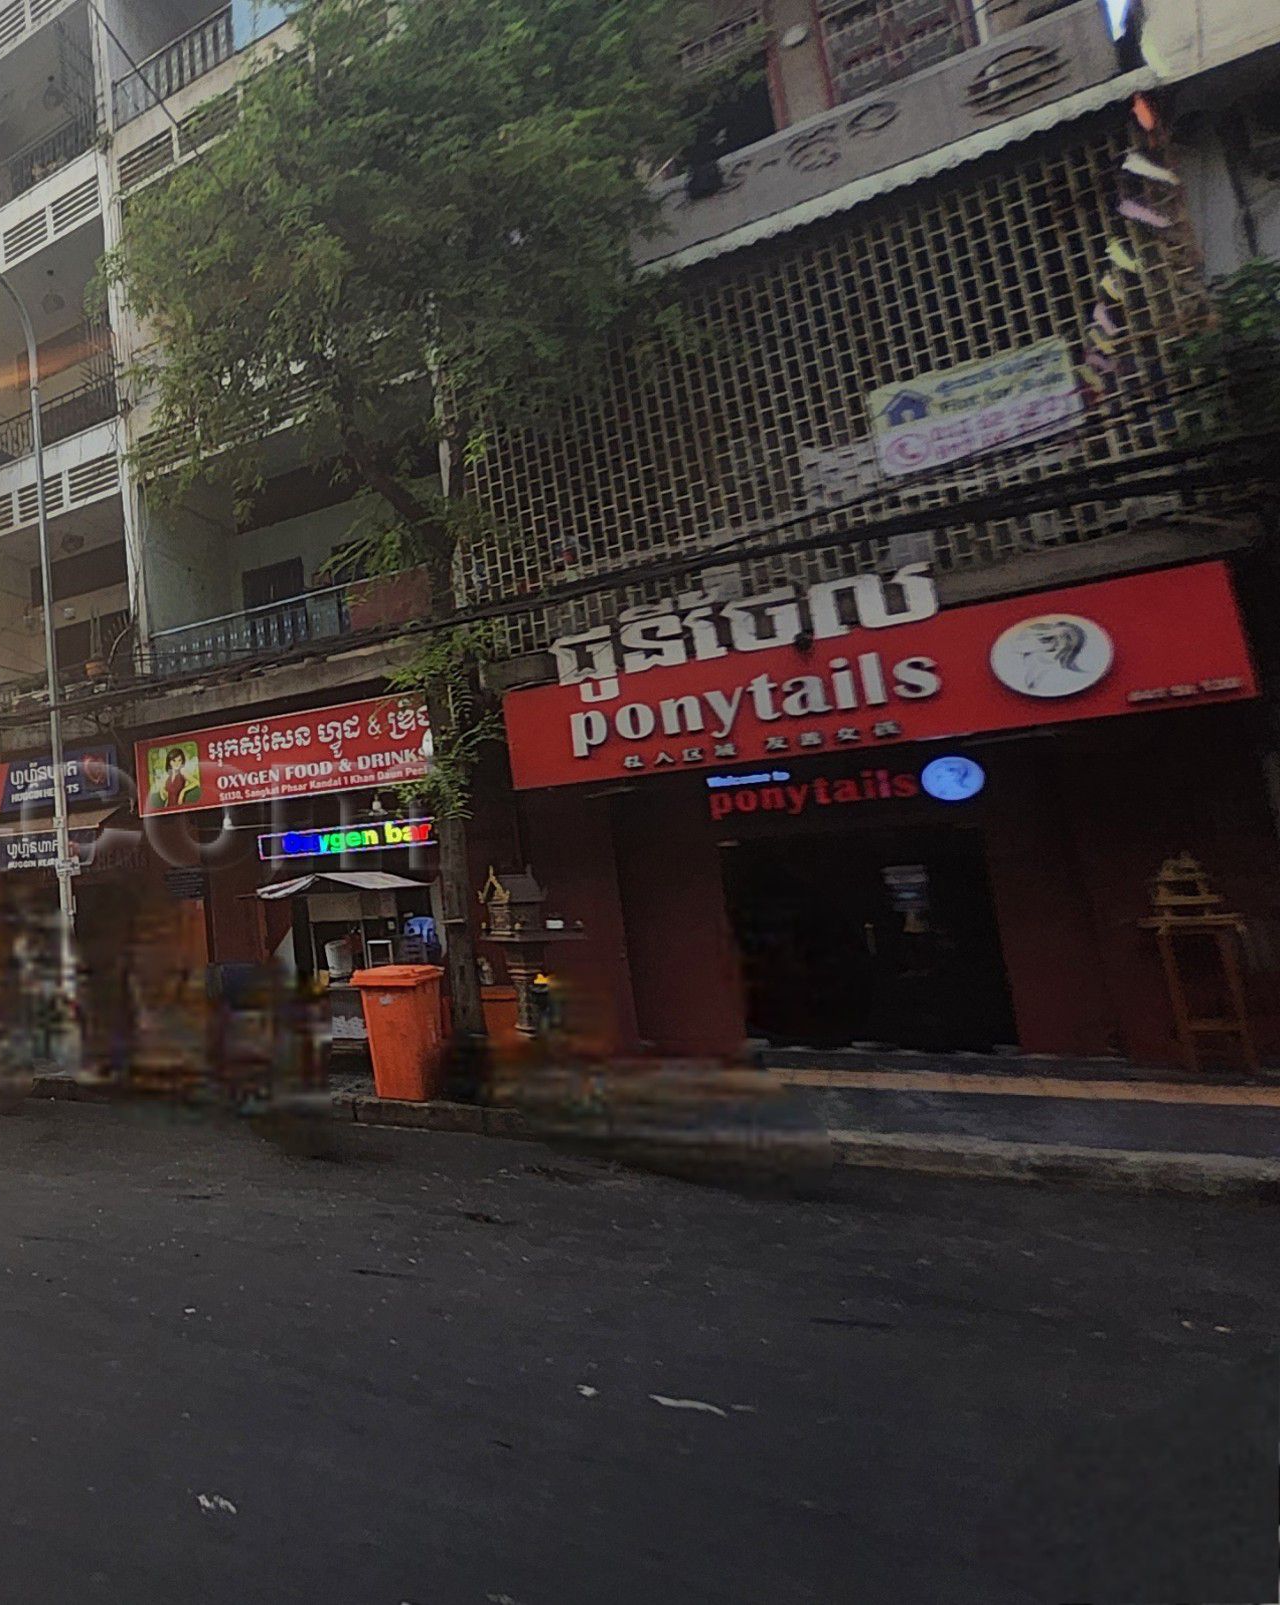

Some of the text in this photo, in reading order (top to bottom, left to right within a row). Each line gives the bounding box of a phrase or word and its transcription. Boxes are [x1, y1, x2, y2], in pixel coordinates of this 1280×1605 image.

[569, 651, 942, 760] ponytails
[217, 747, 426, 790] OXYGEN FOOD & DRINKS
[281, 782, 308, 794] Phsar
[309, 776, 342, 790] Kandal
[350, 773, 375, 785] Khan
[43, 783, 80, 798] HETS
[709, 769, 920, 820] ponytails
[384, 820, 432, 844] bar
